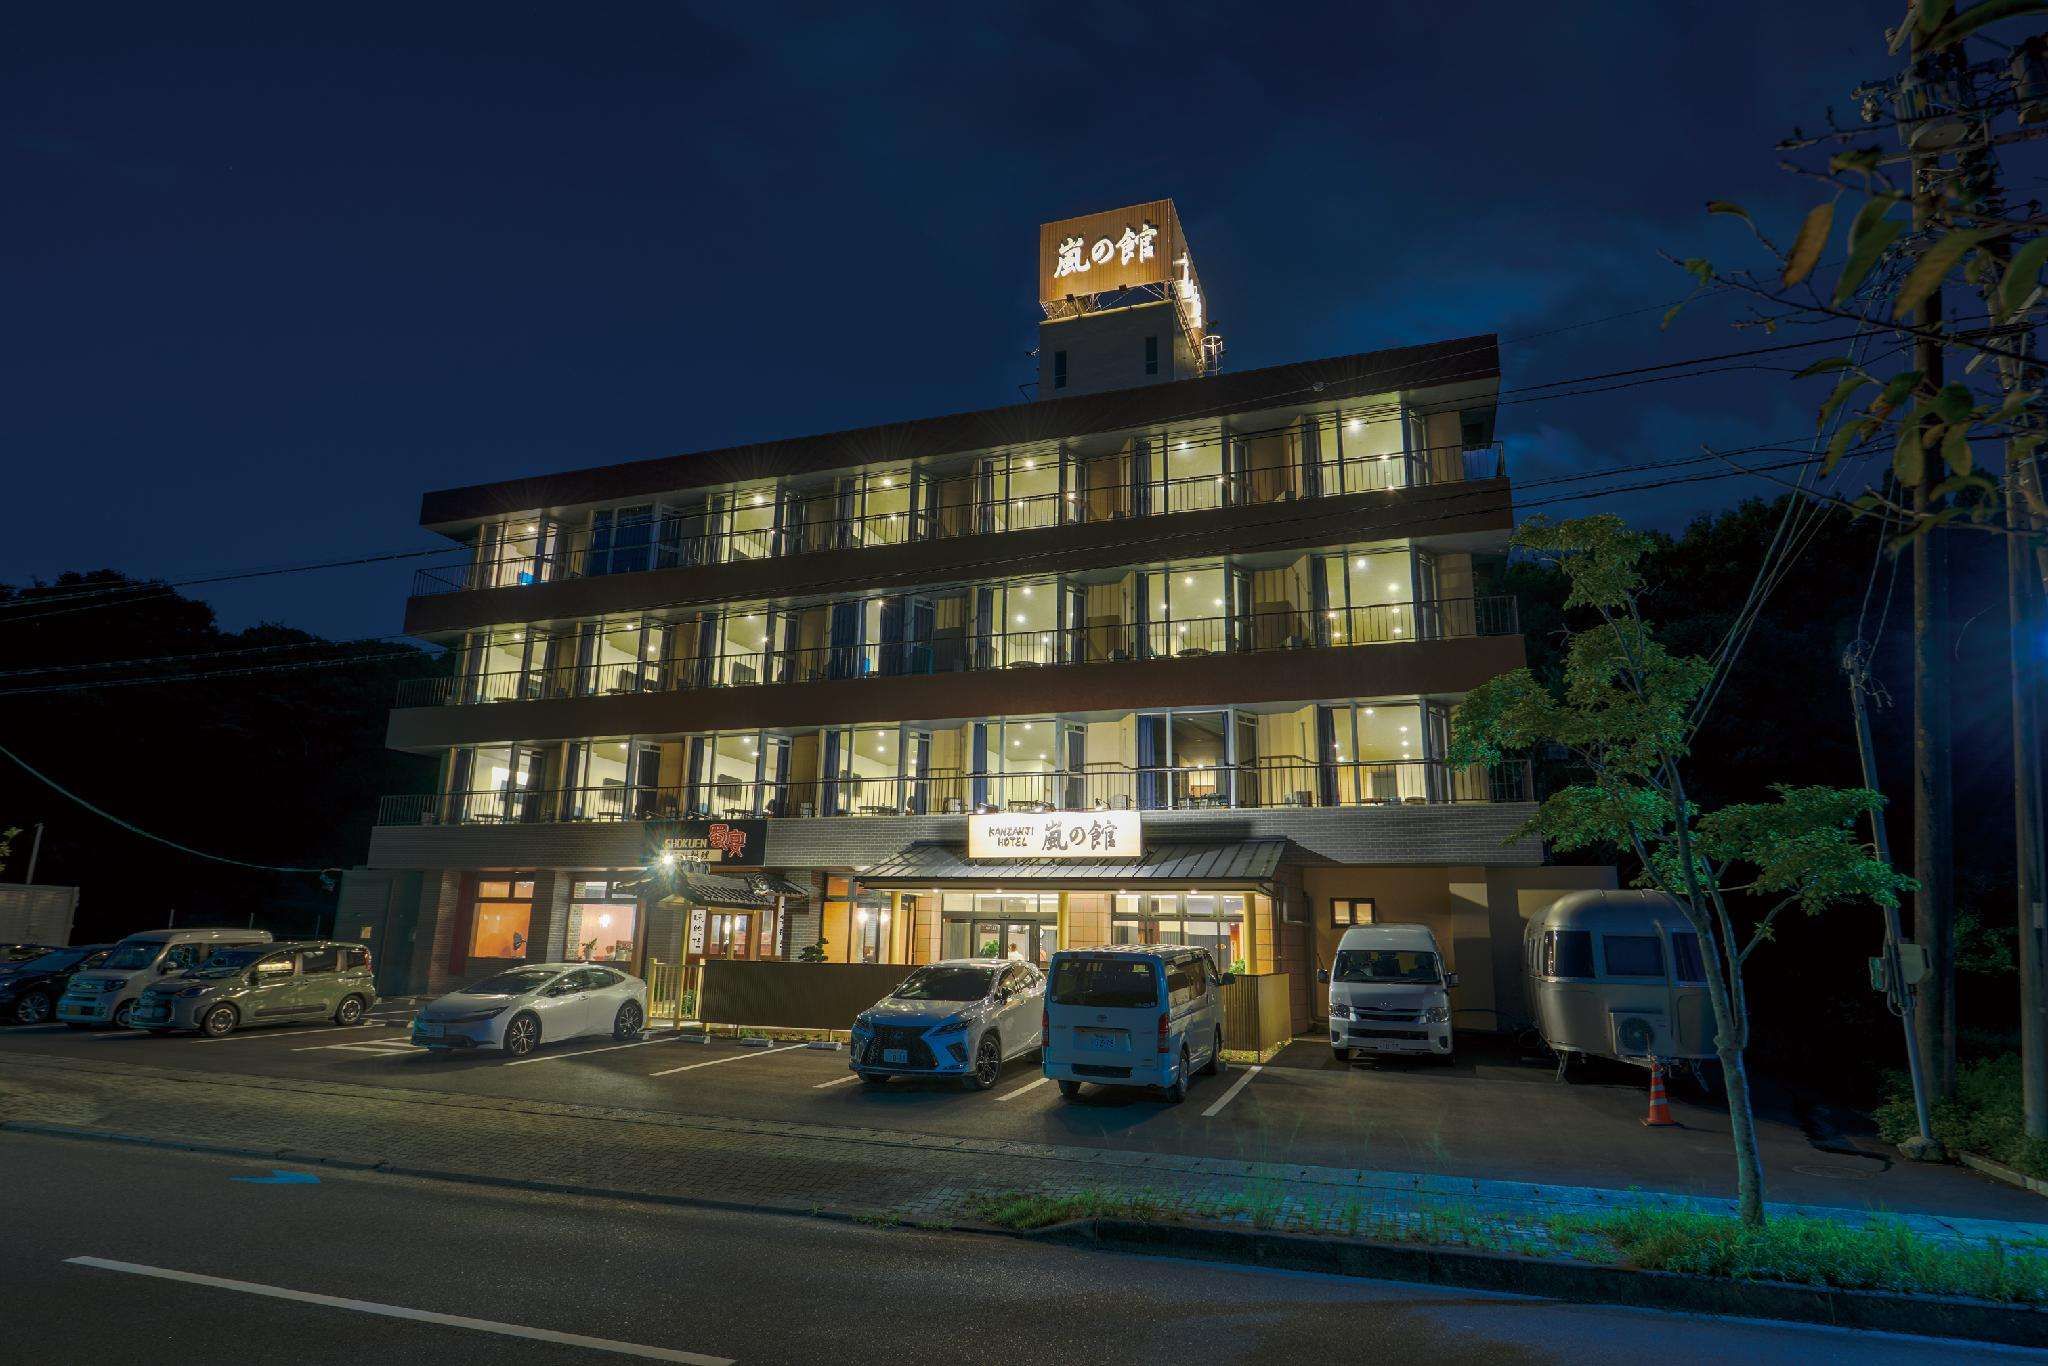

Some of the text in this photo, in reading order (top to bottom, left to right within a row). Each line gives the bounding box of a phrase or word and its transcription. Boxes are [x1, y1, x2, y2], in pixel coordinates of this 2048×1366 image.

[1054, 220, 1159, 279] 嵐の館
[997, 836, 1028, 847] HOTEL
[1042, 820, 1118, 851] 嵐の館
